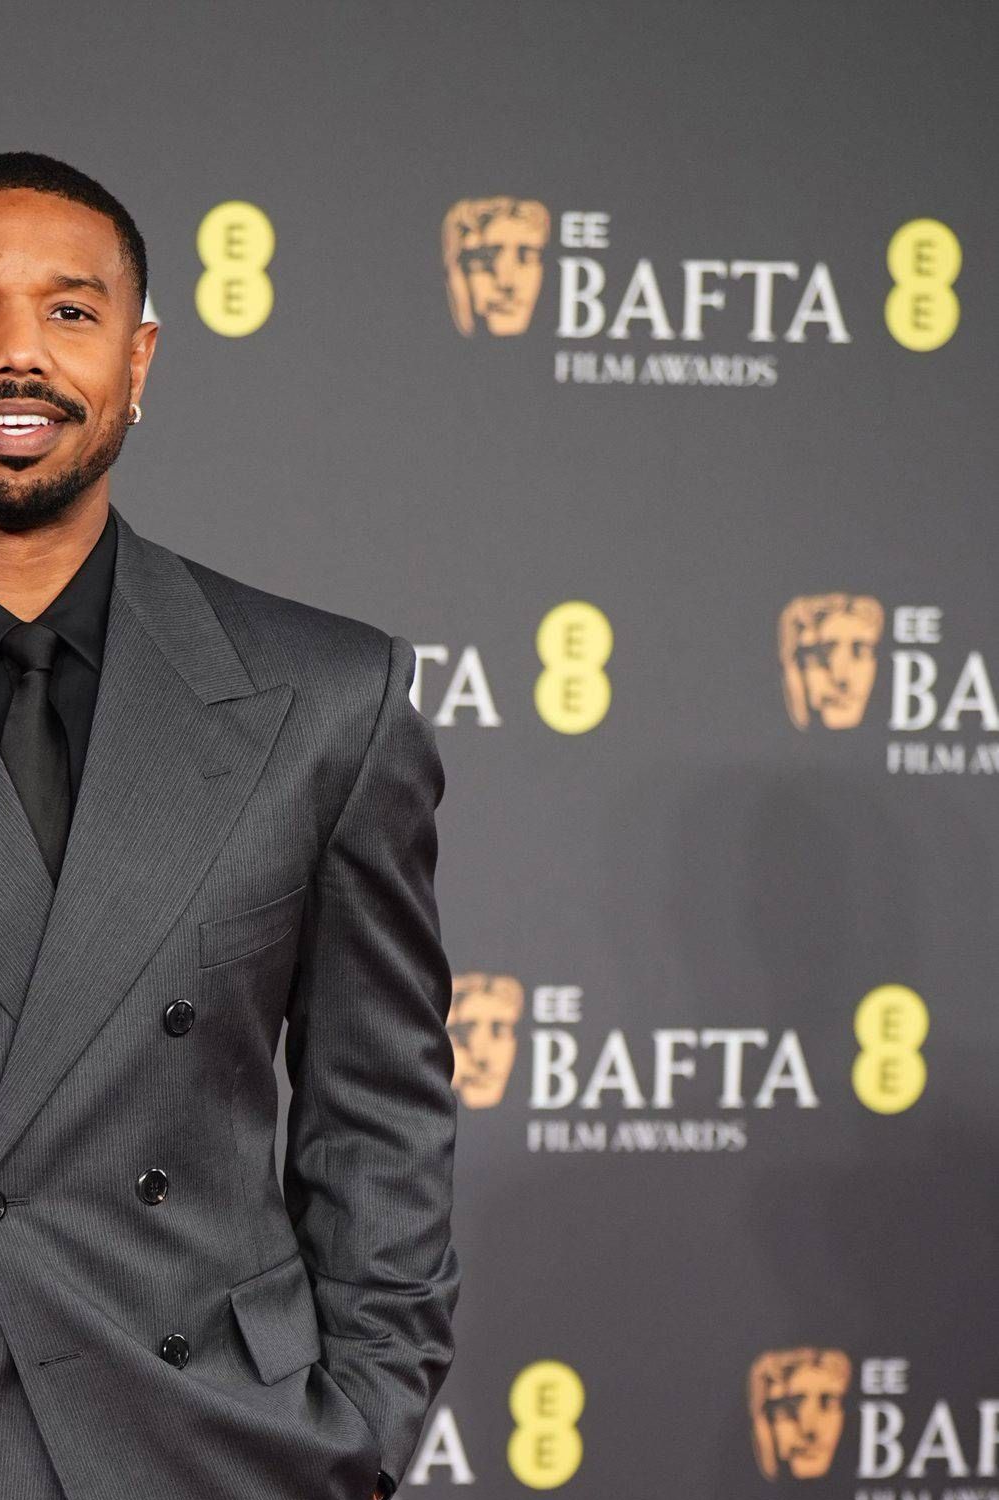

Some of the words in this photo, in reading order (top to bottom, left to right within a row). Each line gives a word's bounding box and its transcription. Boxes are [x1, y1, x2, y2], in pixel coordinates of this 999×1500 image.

[561, 212, 609, 248] EE
[558, 257, 849, 343] BAFTA
[555, 352, 635, 383] FILM
[641, 354, 777, 385] AWARDS
[894, 607, 941, 643] EE
[887, 743, 965, 773] FILM
[533, 986, 581, 1022] EE
[530, 1029, 817, 1109] BAFTA
[527, 1121, 607, 1151] FILM
[613, 1121, 746, 1151] AWARDS
[861, 1359, 907, 1394] EE
